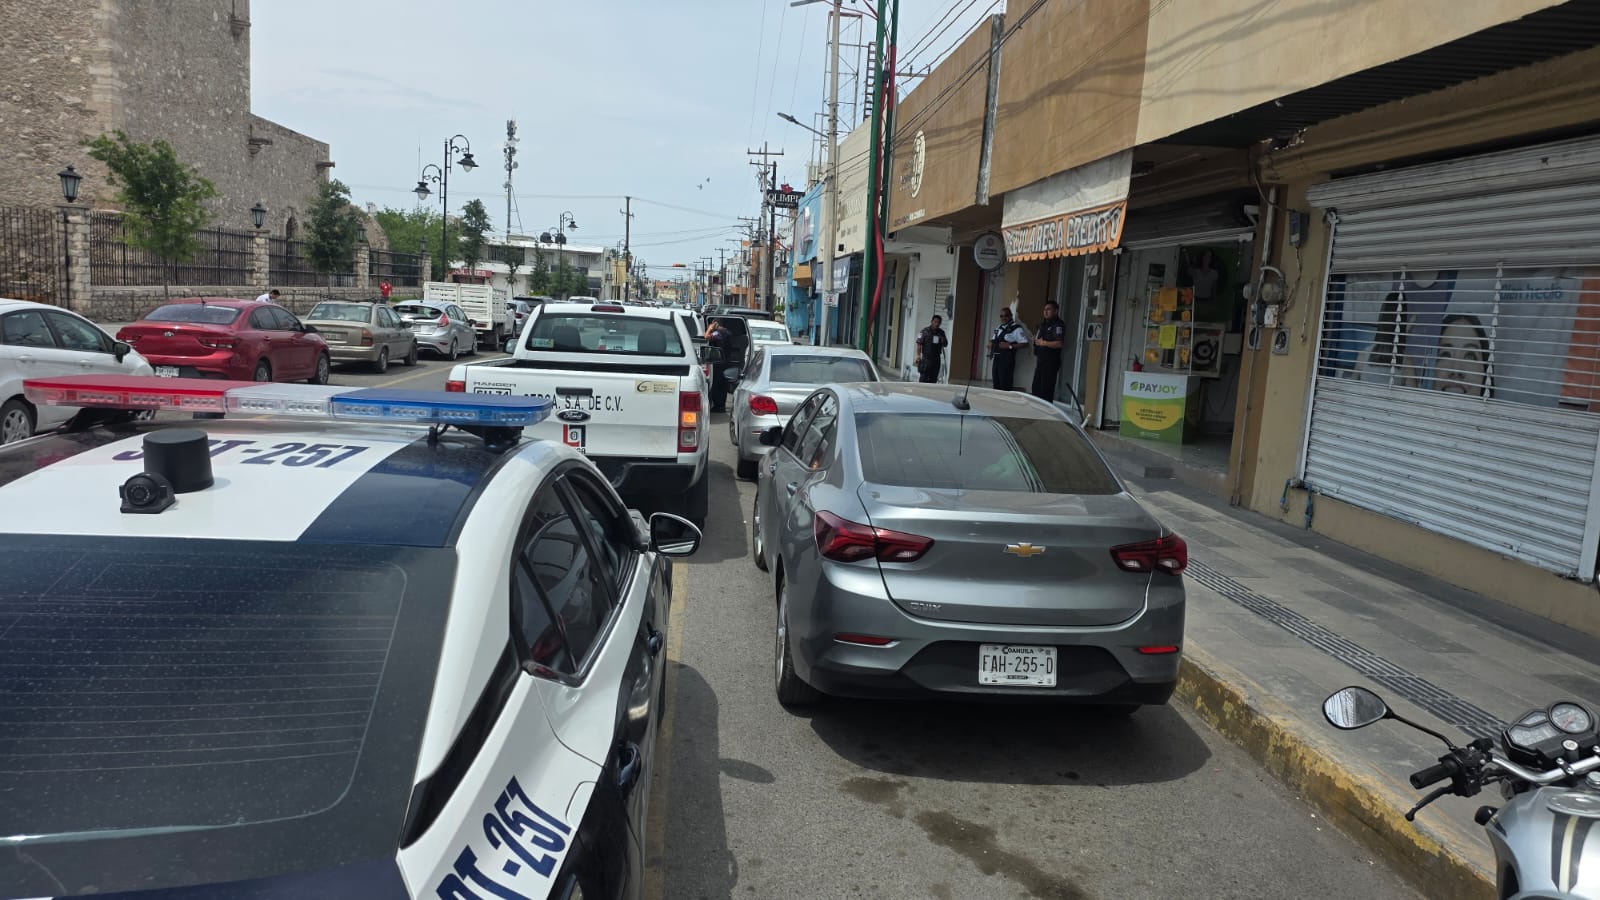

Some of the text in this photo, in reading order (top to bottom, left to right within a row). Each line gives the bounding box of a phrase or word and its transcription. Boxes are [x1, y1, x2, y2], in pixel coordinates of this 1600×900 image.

[1055, 218, 1064, 249] A
[1139, 382, 1178, 394] PAYJOY
[588, 396, 601, 410] DE
[605, 396, 623, 411] C.V.
[1002, 646, 1034, 655] COAHUILA
[983, 655, 1053, 674] FAH-255-D
